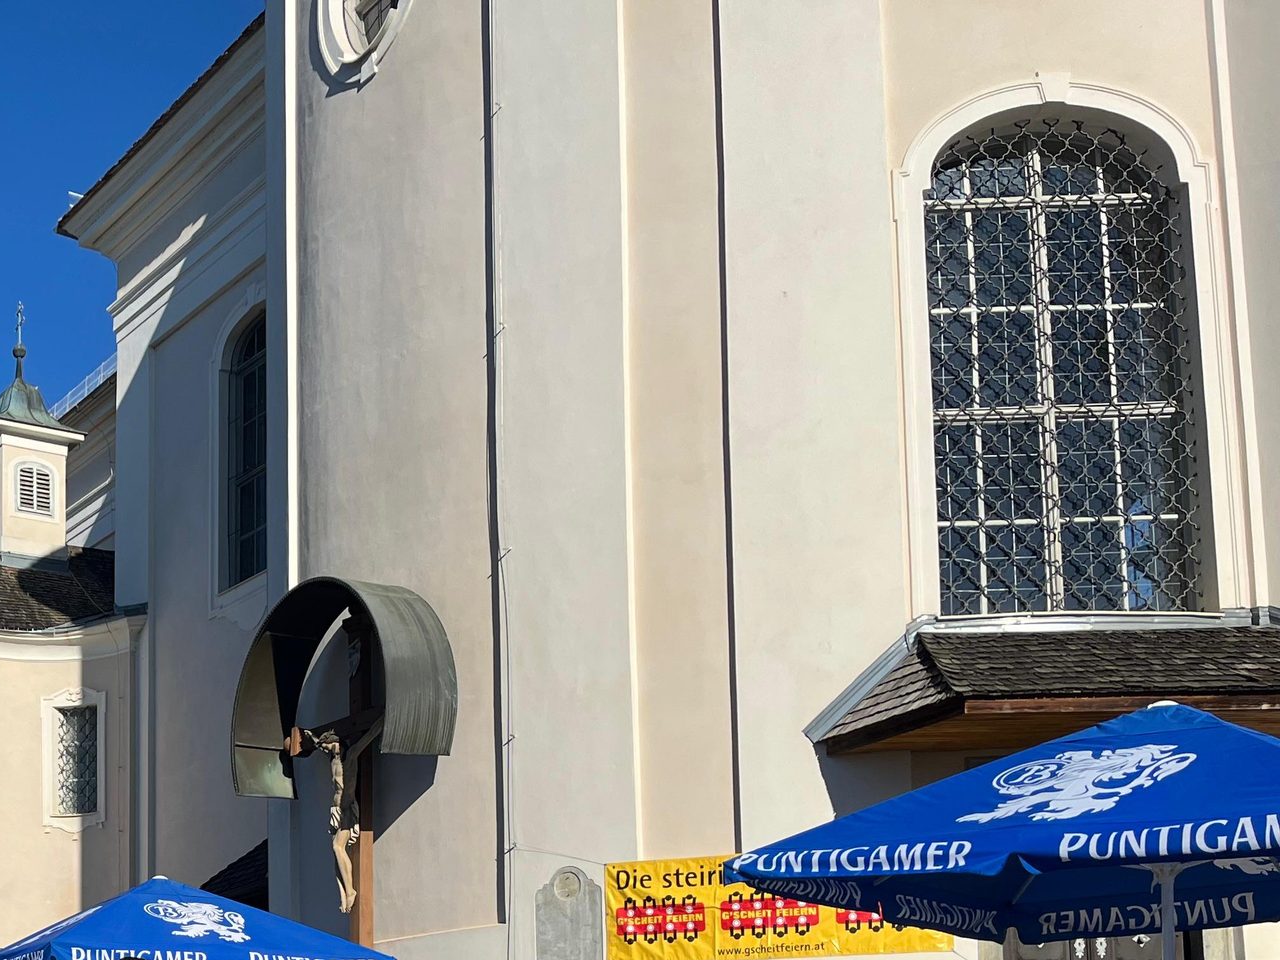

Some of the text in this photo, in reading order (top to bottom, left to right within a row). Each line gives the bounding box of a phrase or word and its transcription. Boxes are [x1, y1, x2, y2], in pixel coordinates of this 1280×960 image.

[732, 840, 973, 874] PUNTIGAMER
[616, 864, 724, 890] Die steiri
[666, 912, 704, 924] FEIERN
[721, 907, 817, 921] G'SCHEIT FEIERN
[717, 941, 825, 957] www.gscheitfeiern.at
